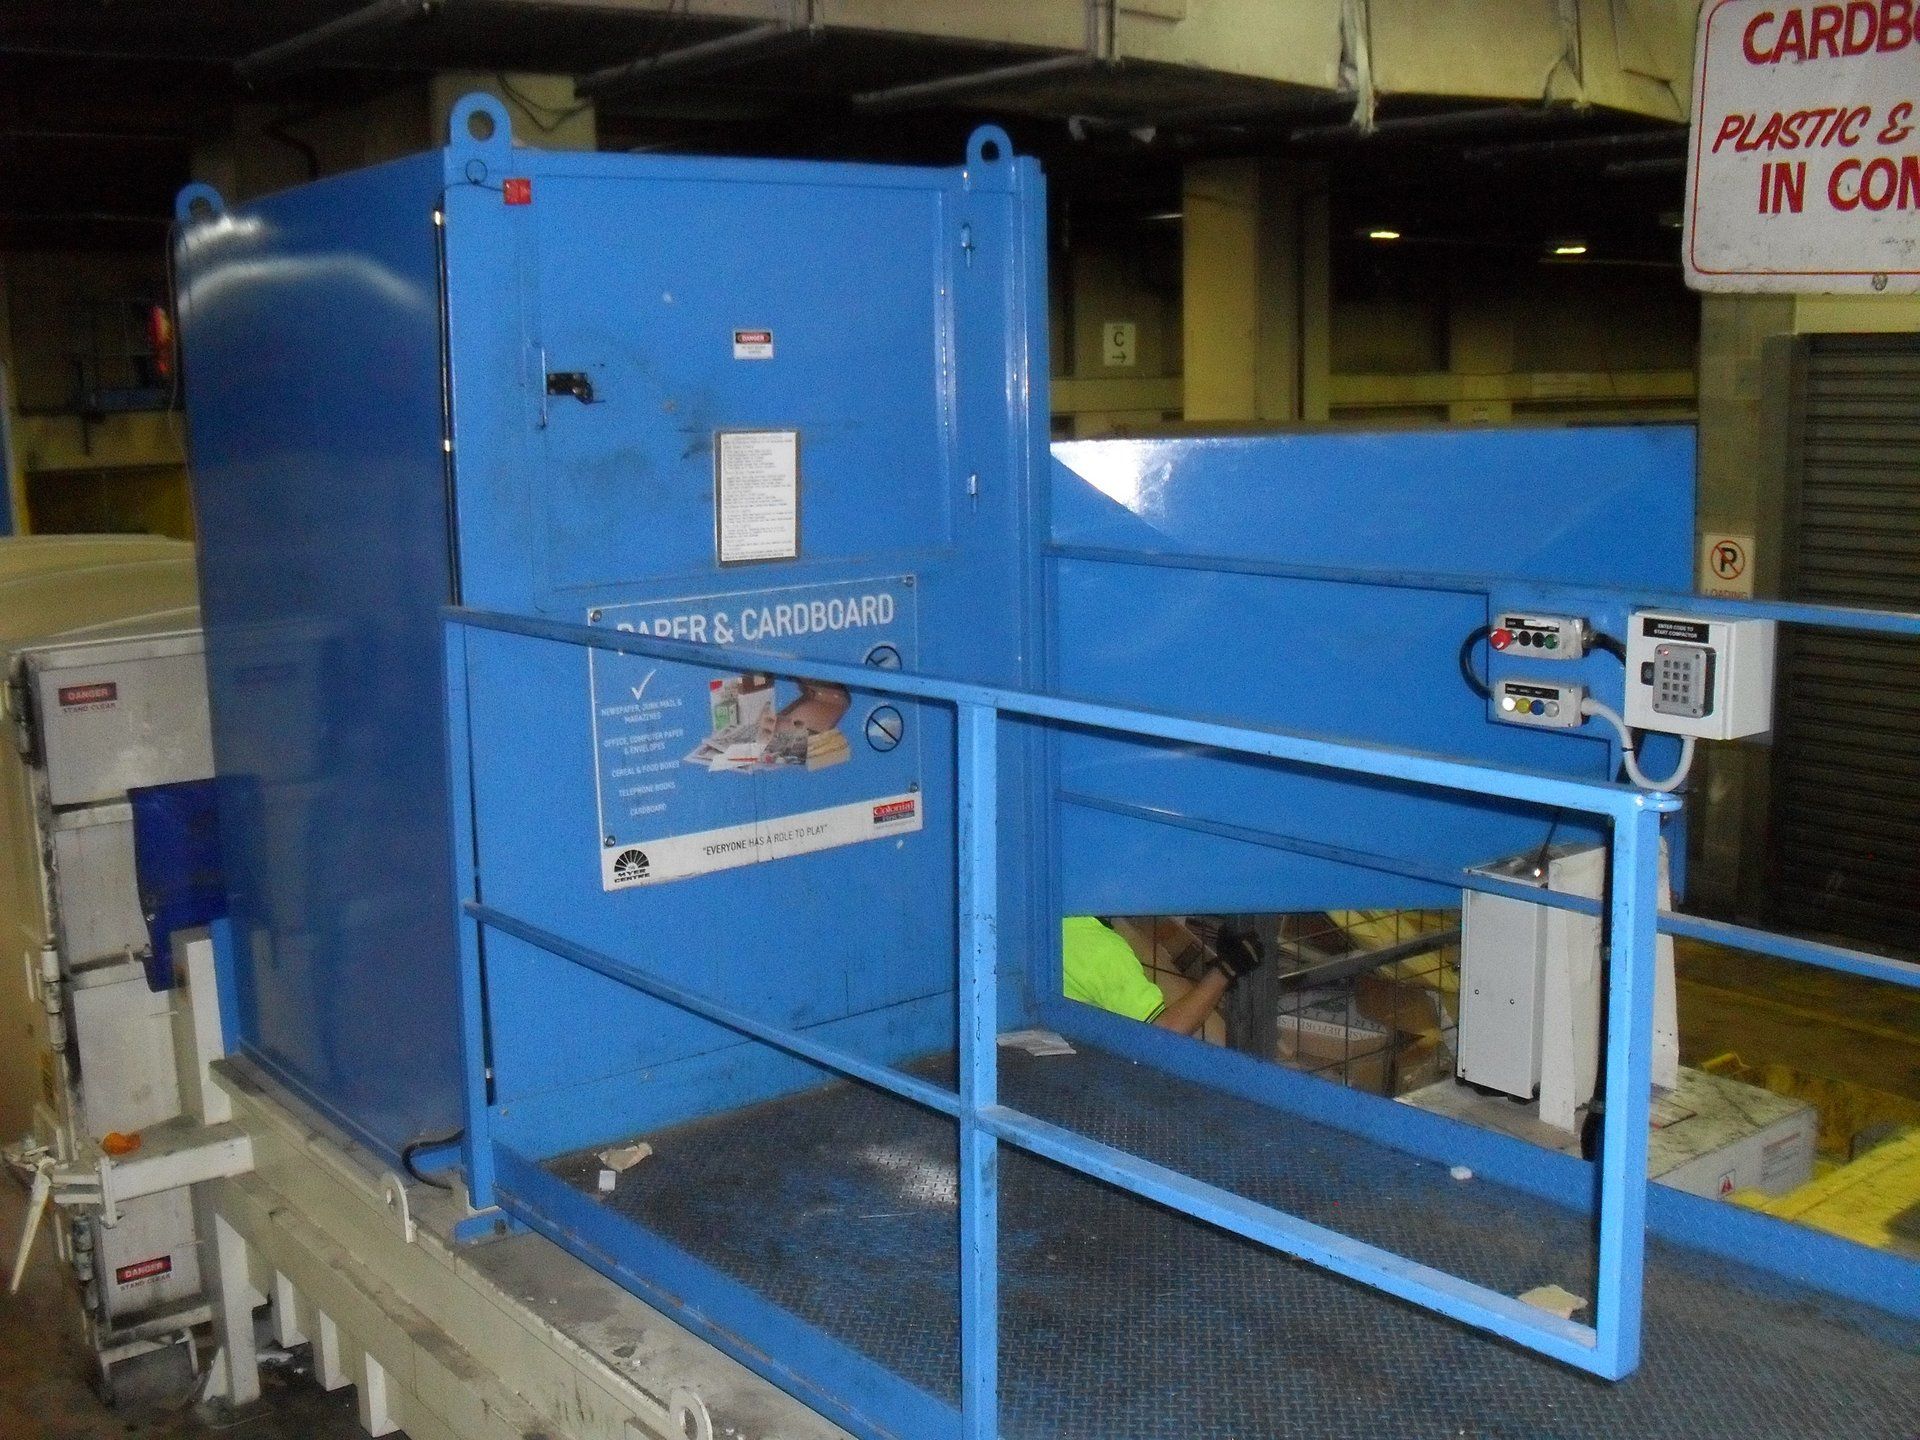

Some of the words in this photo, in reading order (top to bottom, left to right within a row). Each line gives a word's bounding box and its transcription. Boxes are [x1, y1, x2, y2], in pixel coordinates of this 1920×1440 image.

[1743, 0, 1920, 65] CARDB
[1711, 105, 1871, 154] PLASTIC
[1876, 102, 1915, 144] &
[1758, 161, 1807, 214] IN
[1827, 156, 1920, 212] CON
[1113, 331, 1125, 347] C
[713, 613, 735, 644] &
[741, 594, 894, 641] CARDBOARD
[67, 688, 108, 701] DANGER
[612, 767, 635, 778] CEREAL
[642, 763, 660, 773] FOOD
[660, 759, 680, 770] BOXES
[619, 786, 654, 797] TELEPHONE
[655, 781, 676, 792] BOOKS
[702, 840, 747, 856] "EVERYONE
[749, 837, 765, 847] HAS
[766, 835, 772, 844] A
[774, 831, 793, 843] ROLE
[795, 828, 805, 838] TO
[807, 824, 828, 836] PLAY"
[614, 872, 651, 883] CENTRE
[617, 868, 647, 878] MYER
[125, 1262, 164, 1278] DANGER
